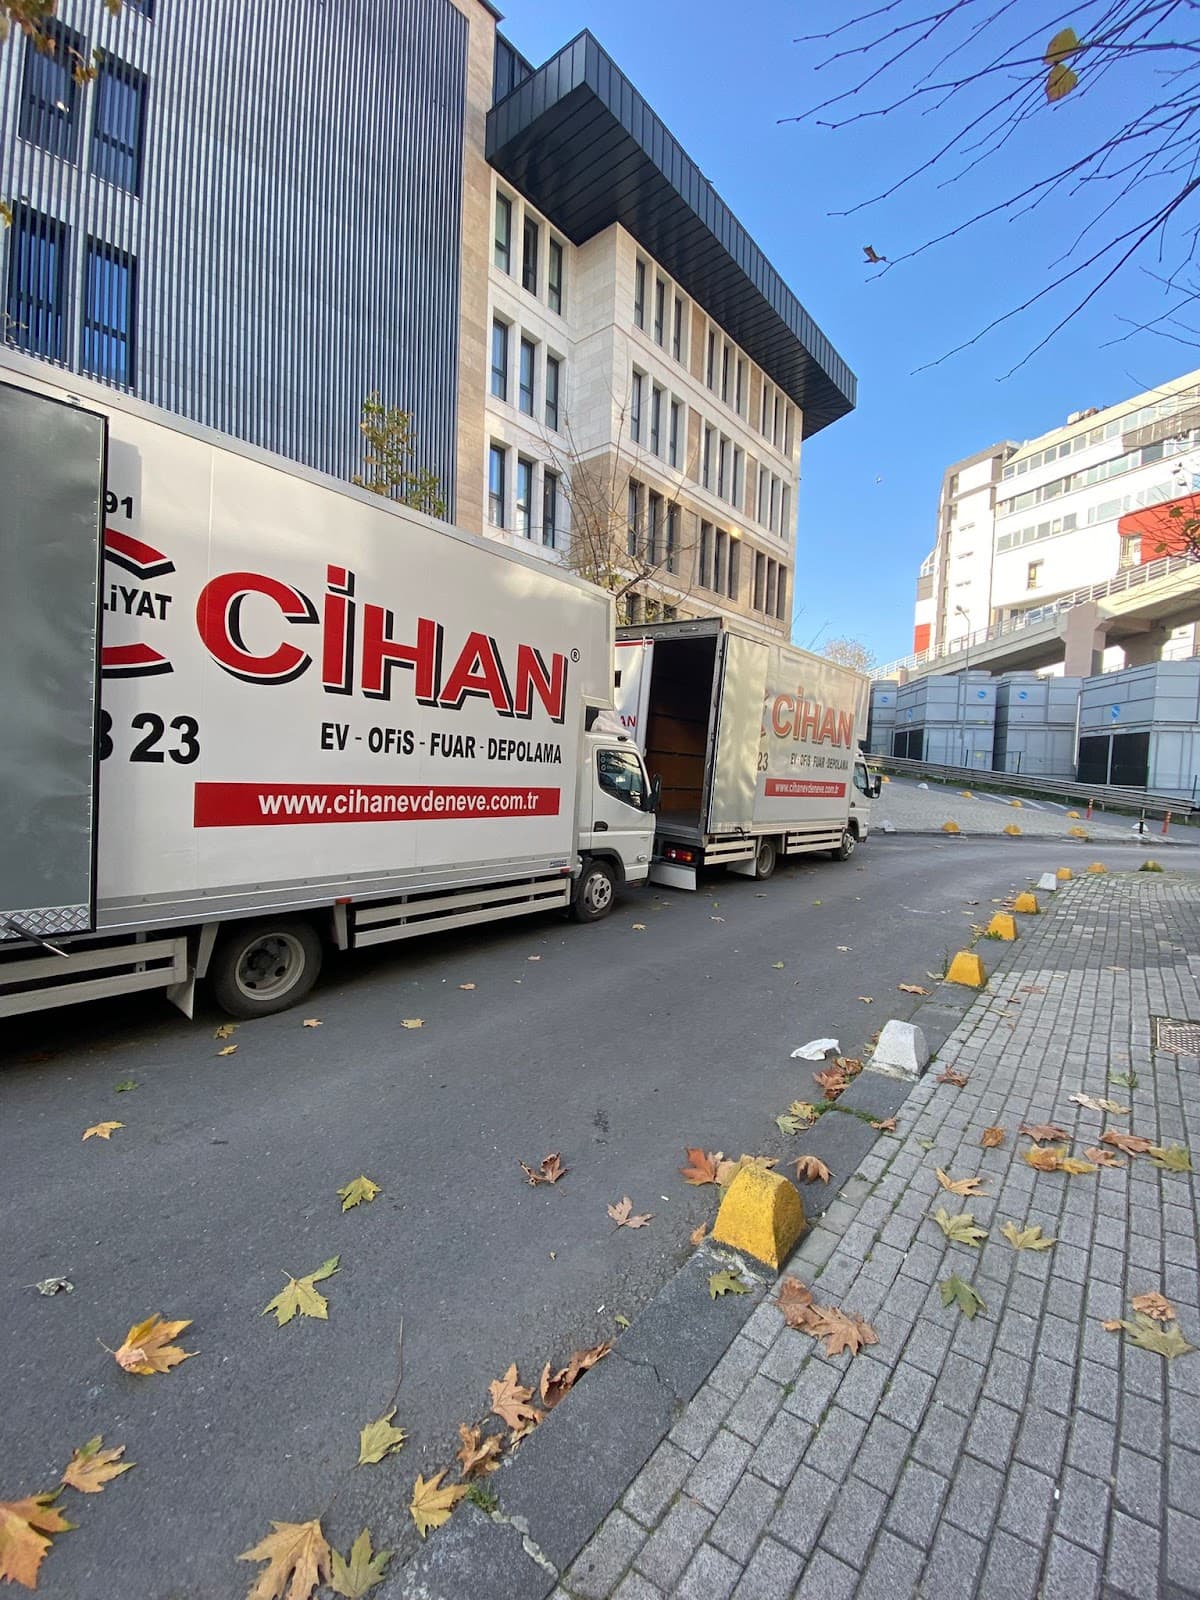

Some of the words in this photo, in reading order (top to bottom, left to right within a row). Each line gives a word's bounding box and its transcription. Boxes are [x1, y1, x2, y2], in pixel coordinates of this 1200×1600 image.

[105, 490, 133, 519] 91
[129, 712, 201, 765] 23
[321, 722, 350, 751] EV
[430, 732, 476, 759] FUAR
[488, 737, 562, 765] DEPOLAMA
[258, 788, 540, 815] www.cihanevdeneve.com.tr
